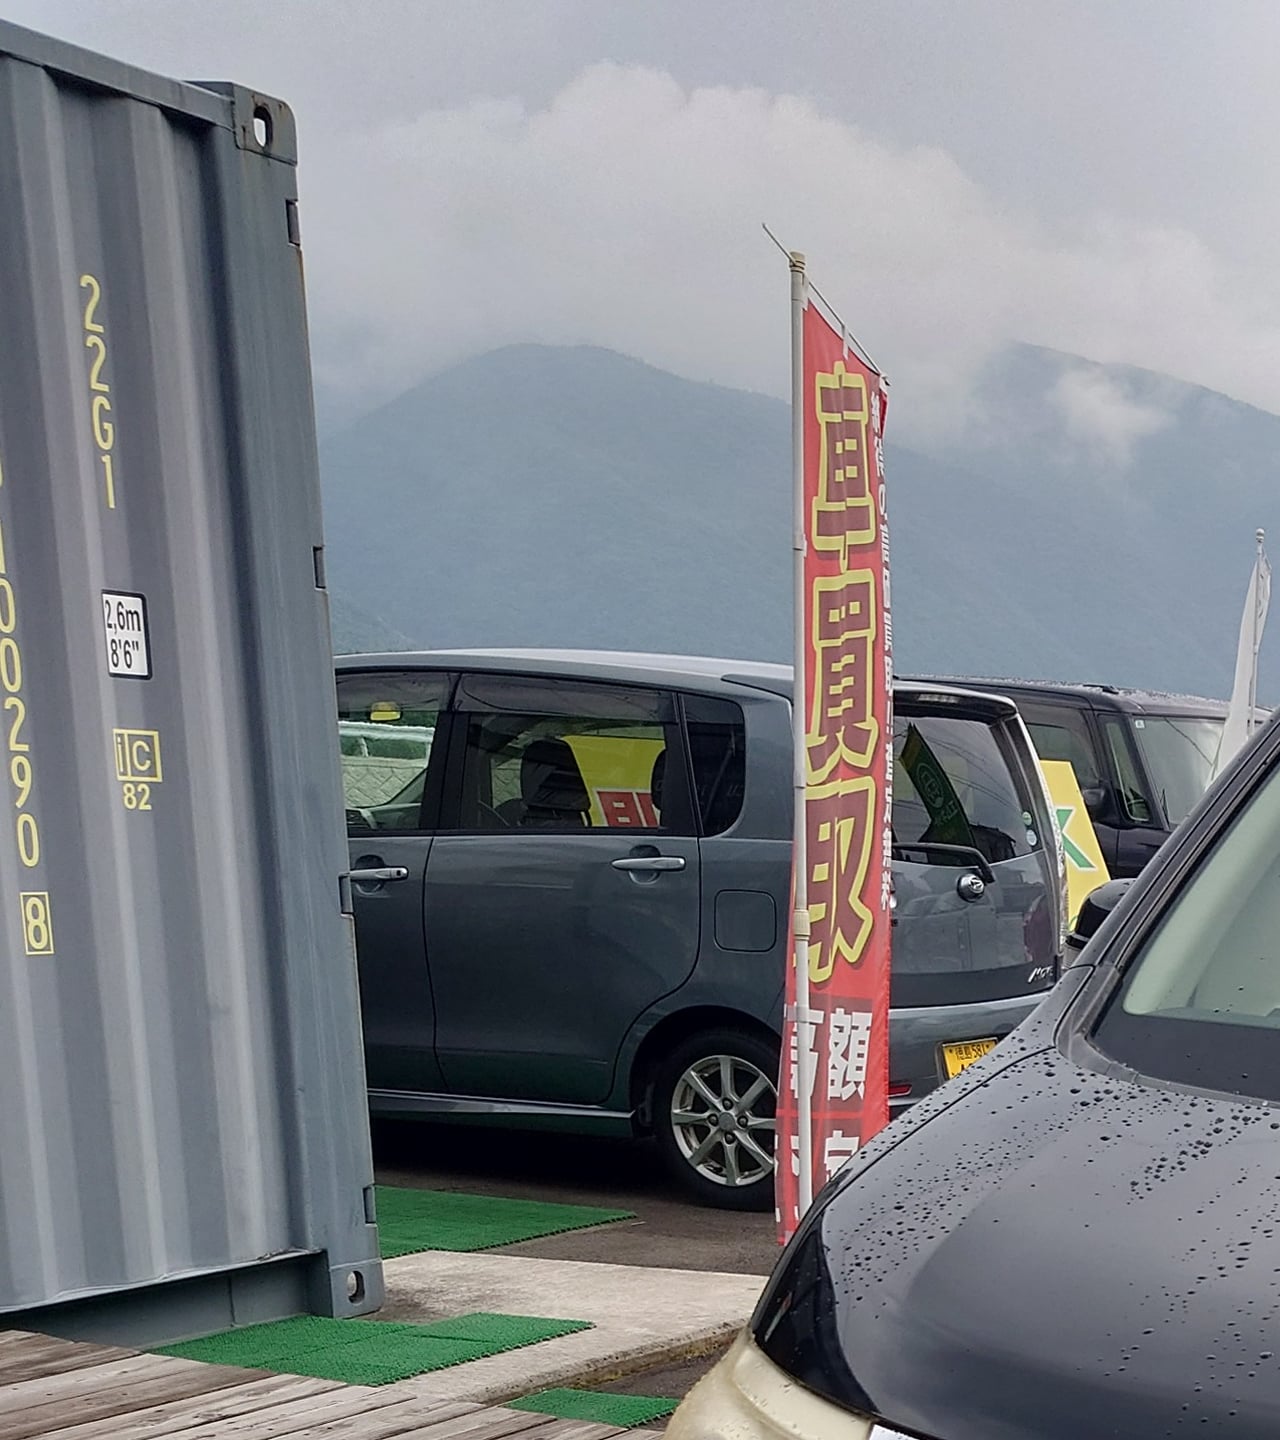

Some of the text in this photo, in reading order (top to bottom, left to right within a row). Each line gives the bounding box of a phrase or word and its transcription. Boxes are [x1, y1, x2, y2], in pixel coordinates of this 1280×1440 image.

[80, 275, 115, 509] 22G1
[793, 360, 878, 983] 車買取
[123, 783, 152, 811] 82
[25, 896, 49, 950] 8
